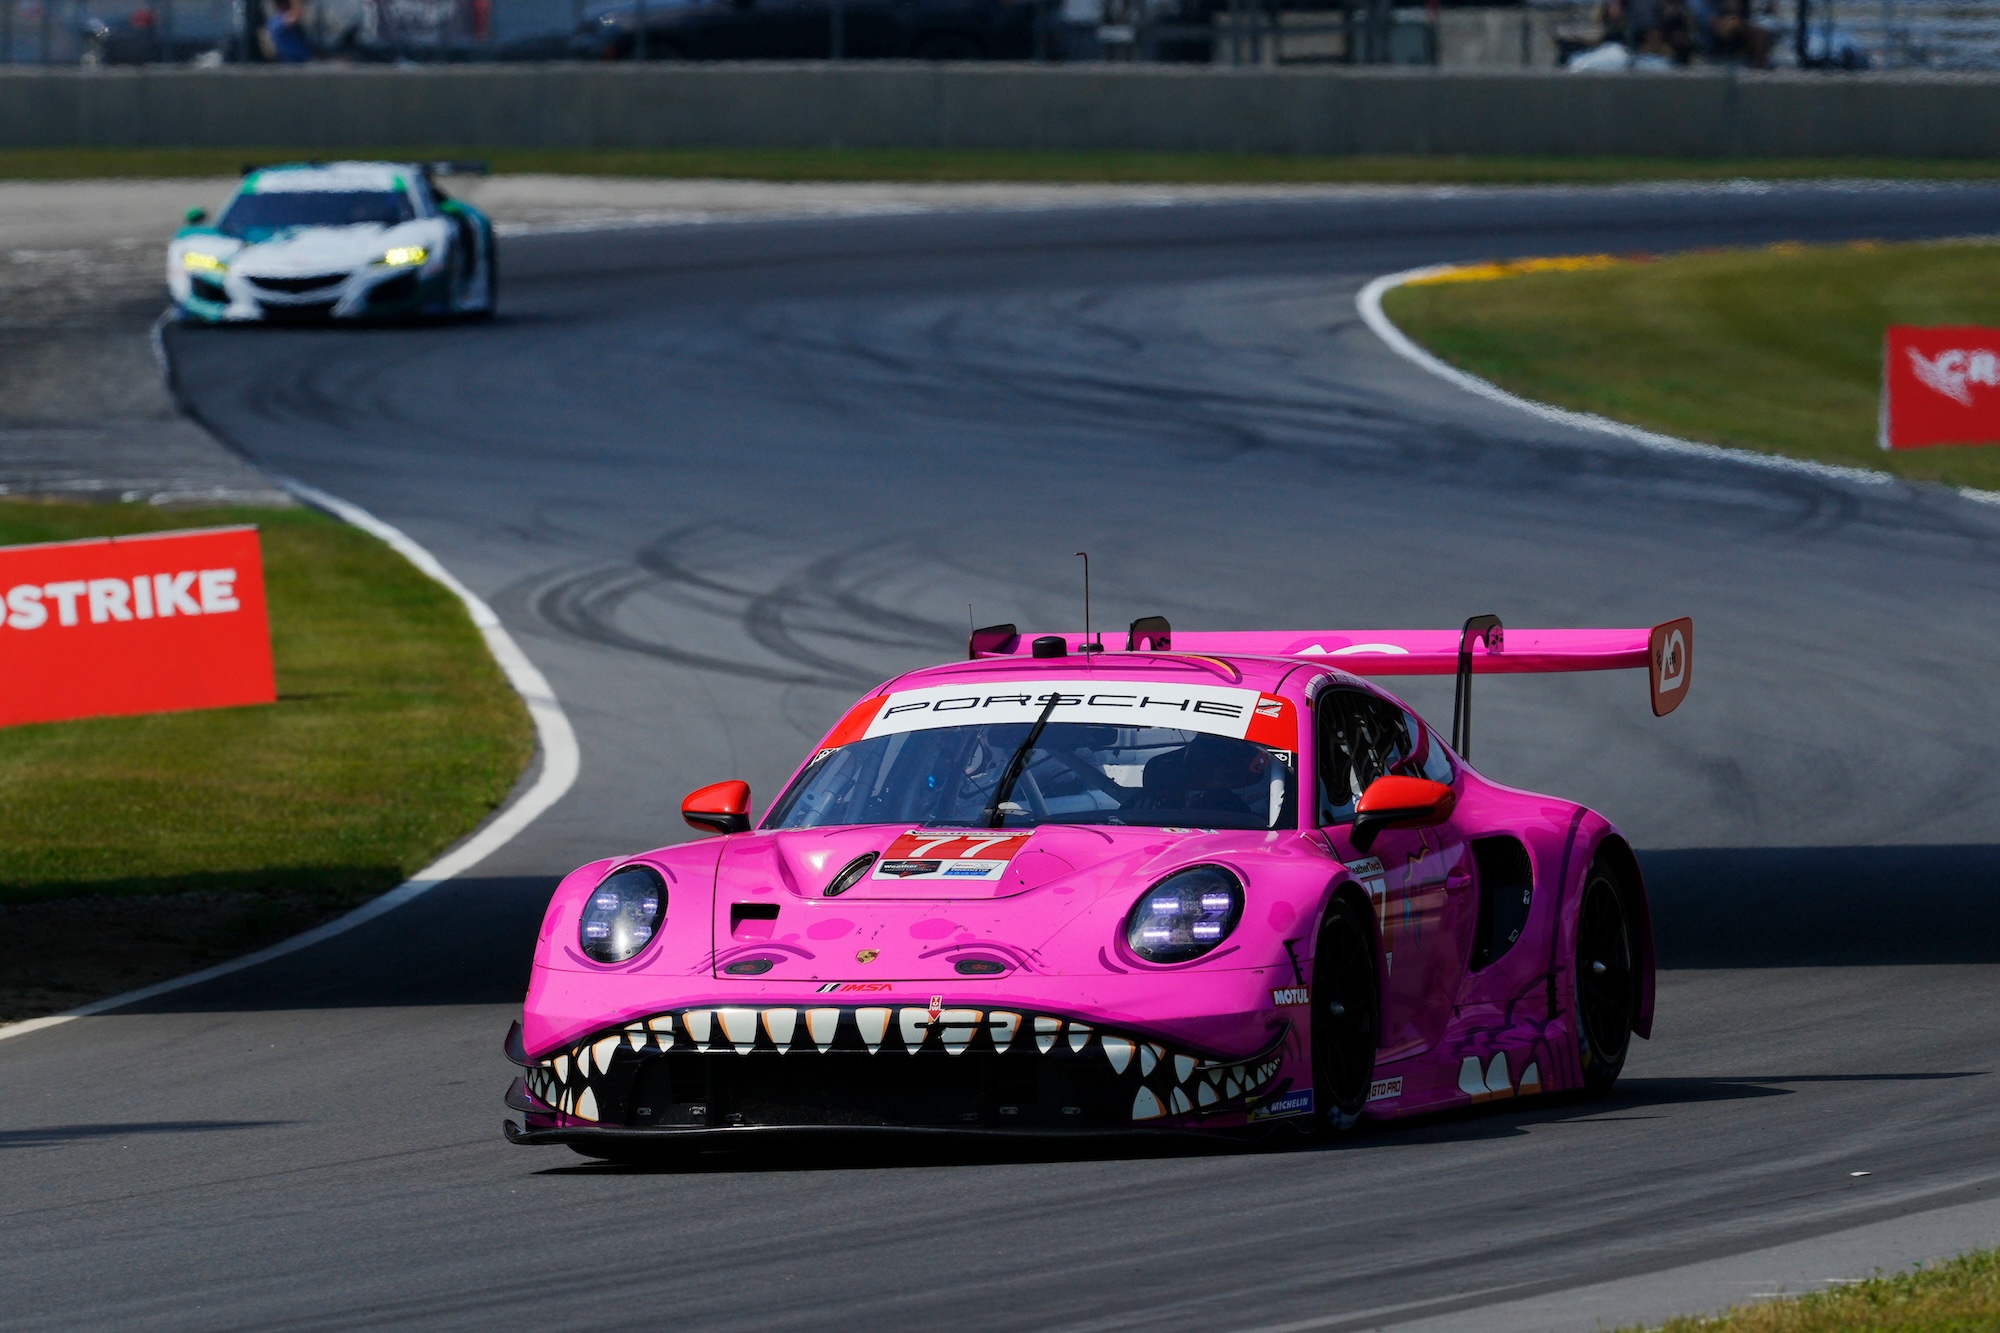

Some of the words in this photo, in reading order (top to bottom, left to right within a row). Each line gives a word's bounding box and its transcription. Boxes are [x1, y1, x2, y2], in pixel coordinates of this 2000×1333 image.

[1934, 349, 2000, 386] CR
[0, 568, 240, 630] STRIKE
[882, 694, 1244, 720] PORSCHE
[908, 836, 1013, 859] 77
[1349, 860, 1382, 874] eatherTech
[840, 983, 893, 992] IMSA
[931, 997, 940, 1011] TOW
[1273, 988, 1309, 1005] MOTUL
[1371, 1083, 1386, 1097] GTD
[1387, 1080, 1401, 1094] PRO
[1271, 1097, 1309, 1112] MICHELIN
